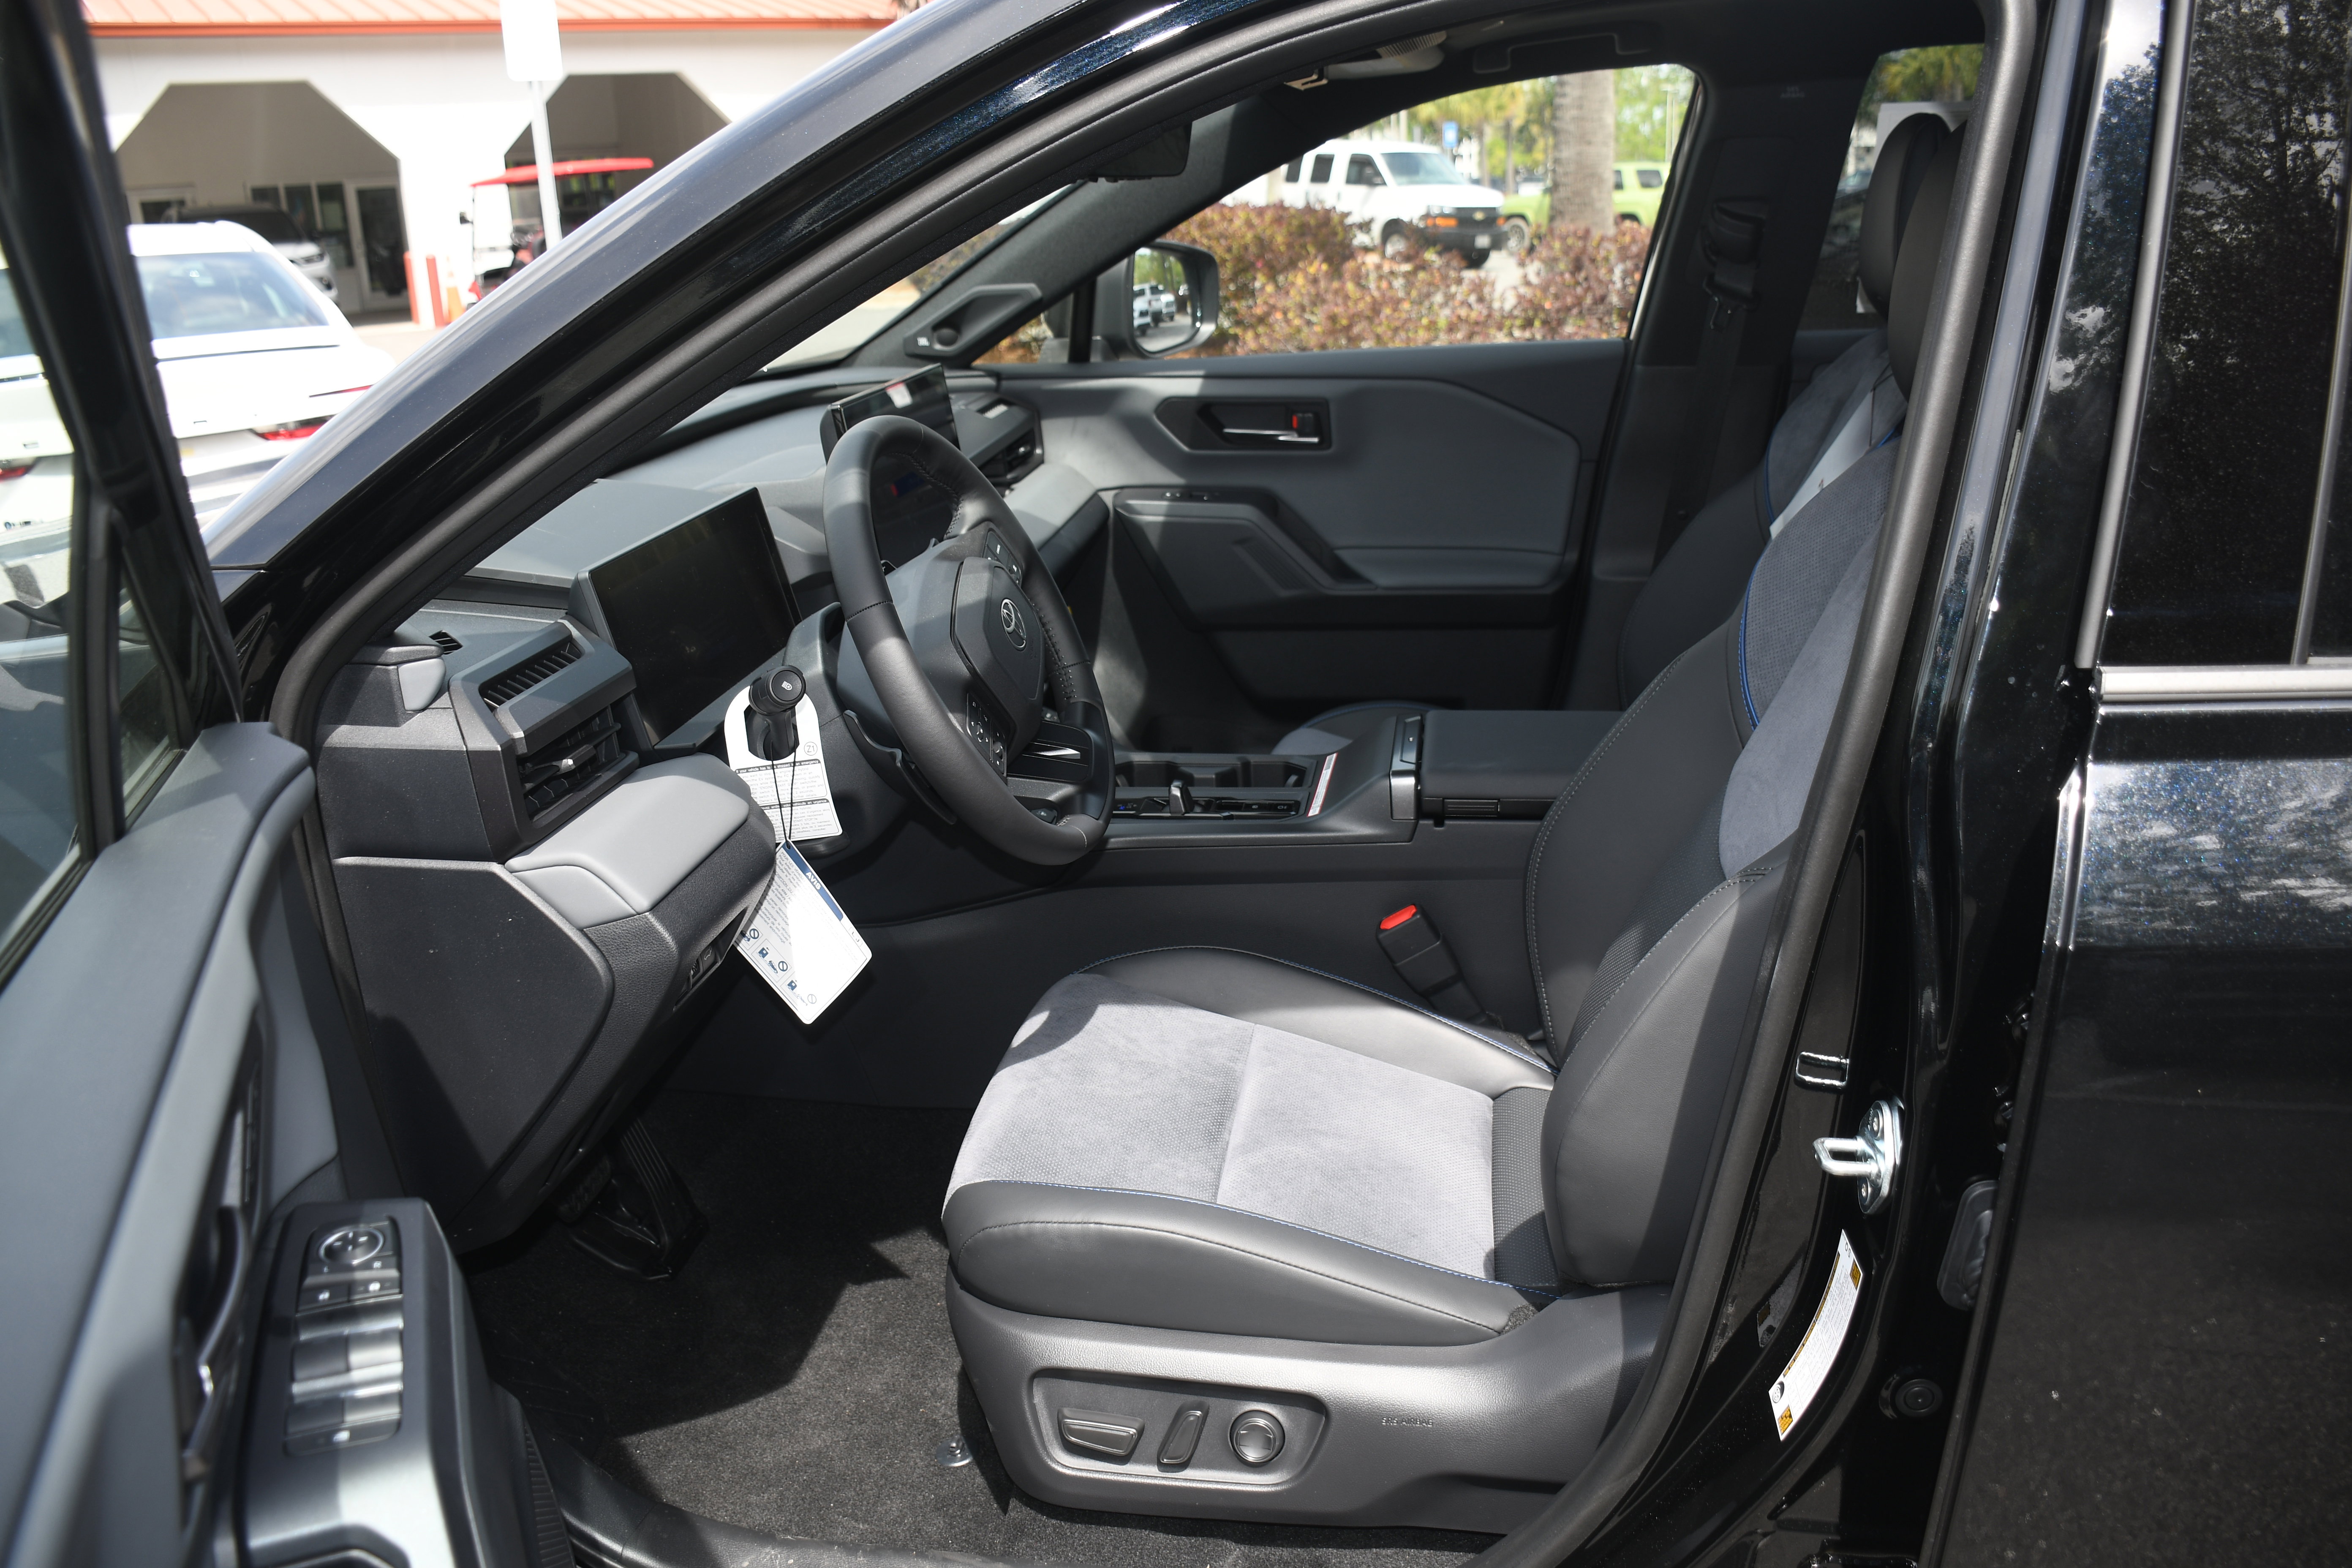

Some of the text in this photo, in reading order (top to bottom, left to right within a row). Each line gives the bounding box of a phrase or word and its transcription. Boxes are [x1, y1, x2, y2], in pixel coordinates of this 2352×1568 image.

[806, 871, 821, 890] AVIS
[1382, 1417, 1433, 1427] SRS AIRBAG
